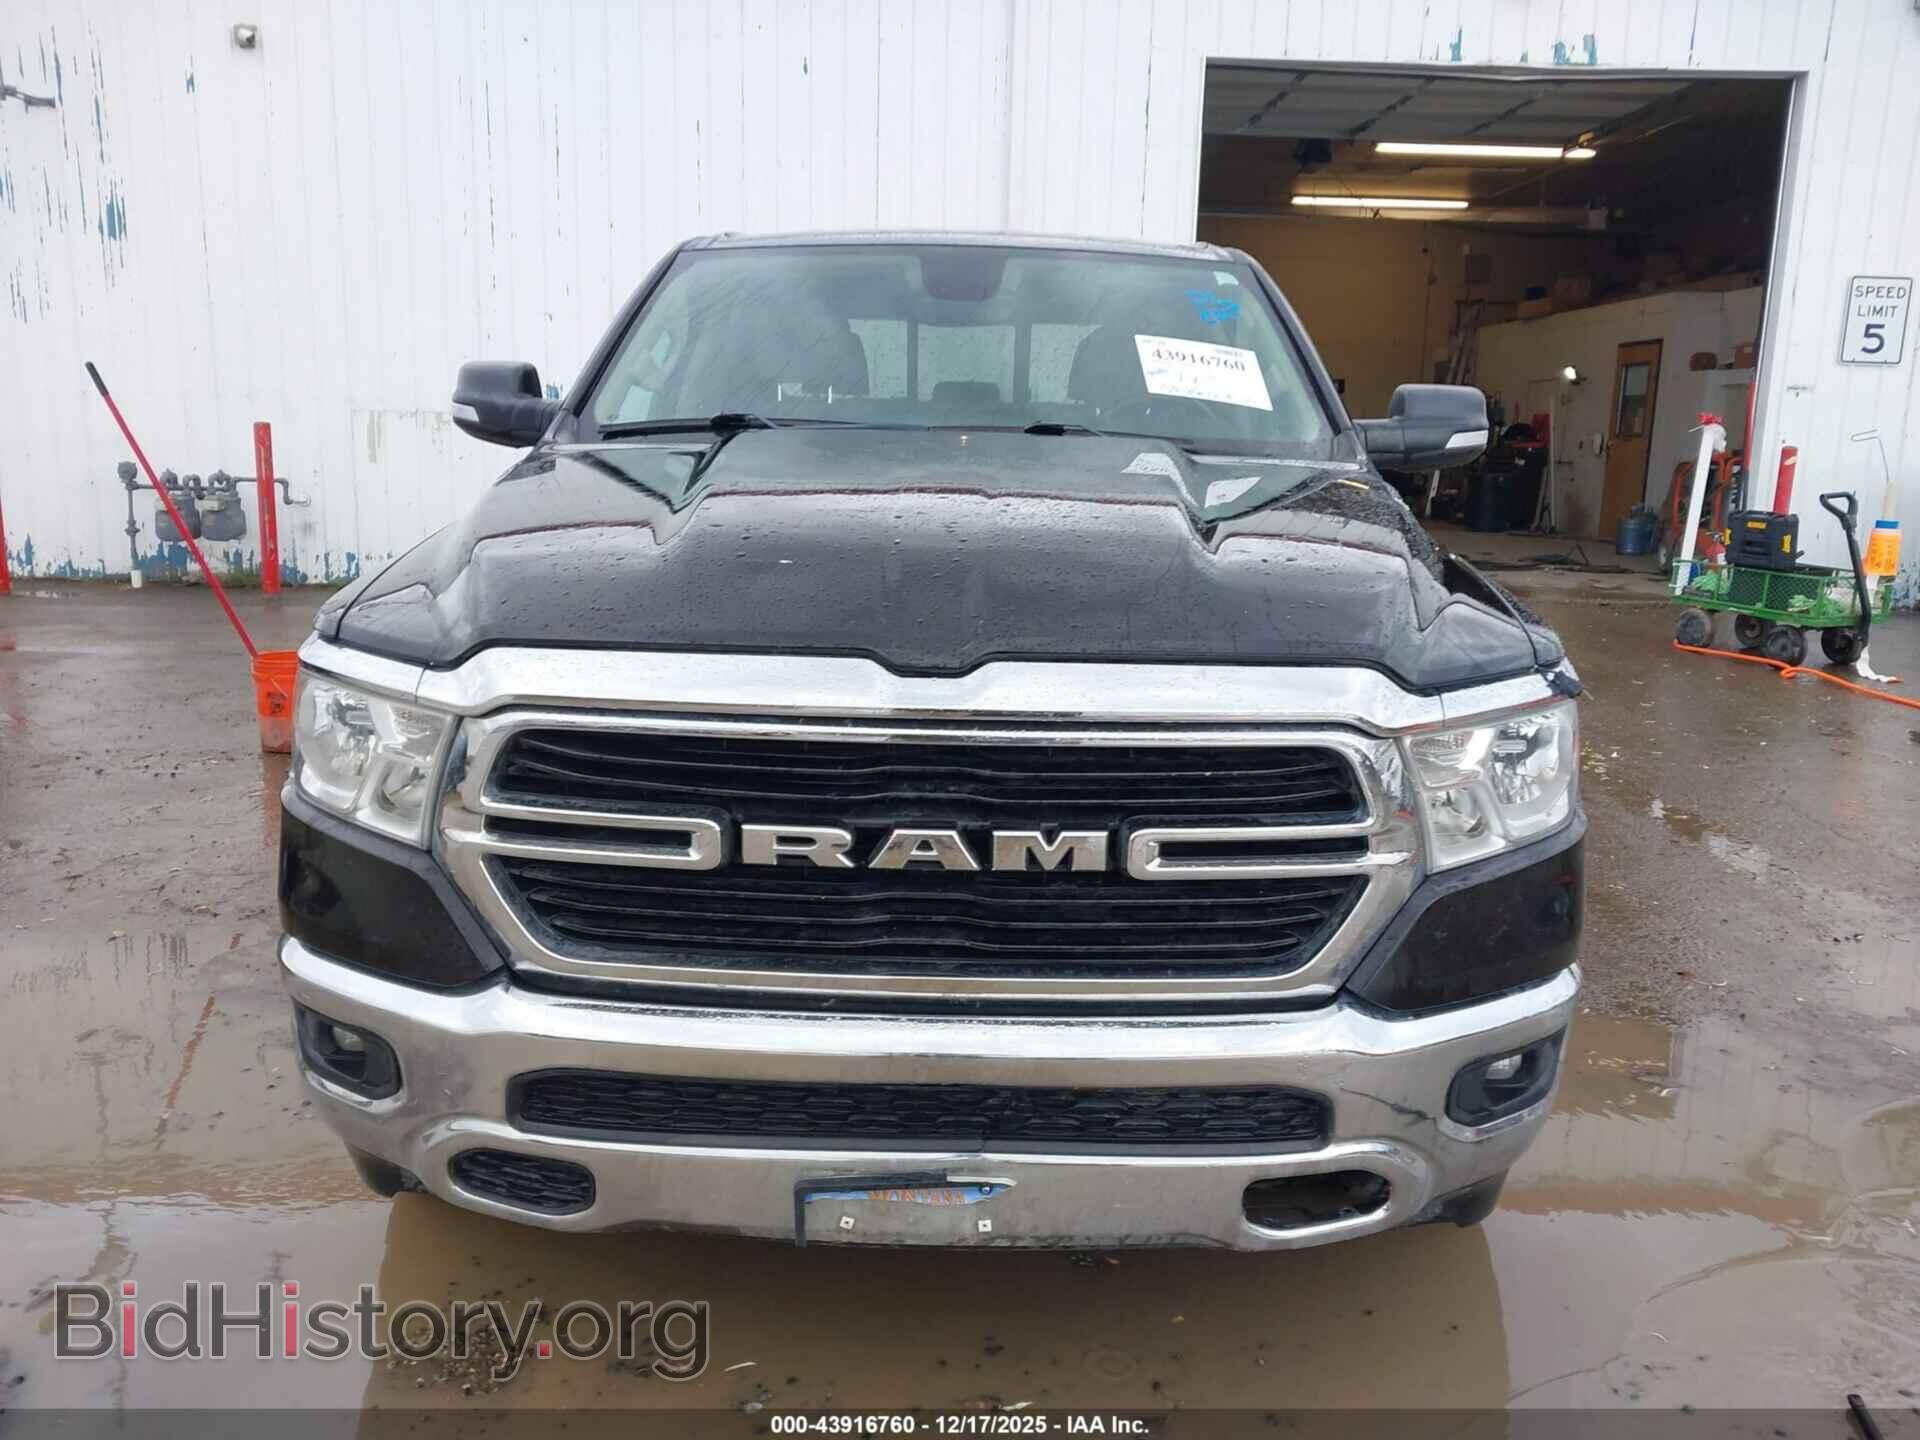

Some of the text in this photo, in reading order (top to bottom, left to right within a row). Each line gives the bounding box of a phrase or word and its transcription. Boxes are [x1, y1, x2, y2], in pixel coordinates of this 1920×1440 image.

[1855, 285, 1907, 299] SPEED
[1857, 304, 1898, 318] LIMIT
[1861, 323, 1886, 354] 5
[1153, 349, 1245, 371] 43916760
[741, 824, 1109, 871] RAM
